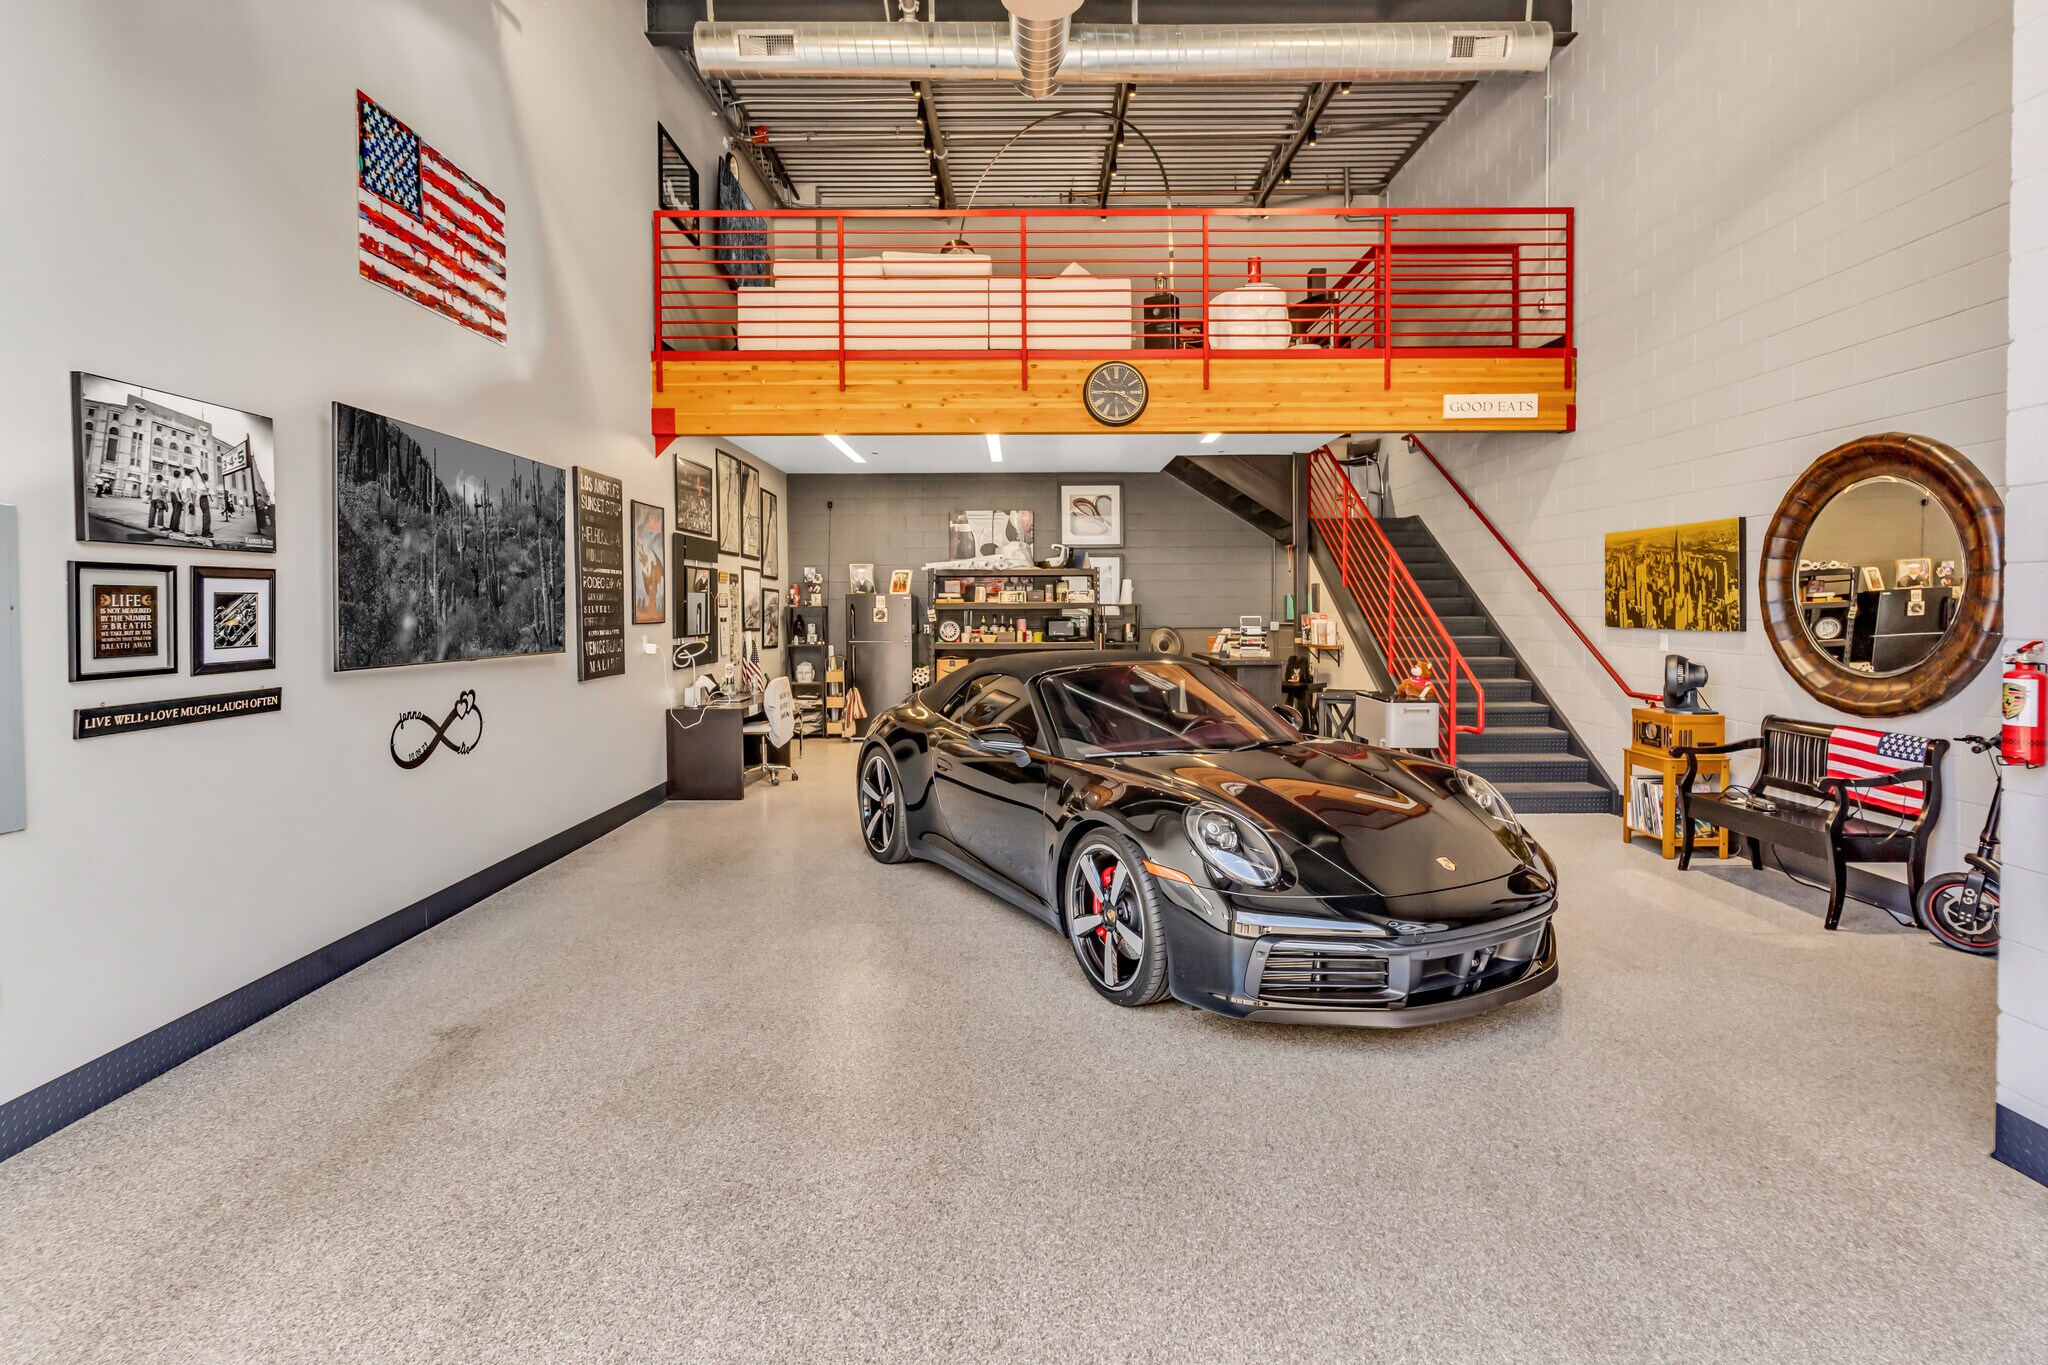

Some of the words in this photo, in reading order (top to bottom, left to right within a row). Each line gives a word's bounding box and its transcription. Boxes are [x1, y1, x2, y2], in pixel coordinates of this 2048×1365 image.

[1449, 401, 1493, 412] GOOD
[1498, 401, 1533, 412] EATS
[580, 474, 593, 492] LOS
[581, 494, 604, 513] SUNSET
[111, 594, 141, 607] LIFE
[110, 622, 153, 630] BREATHS
[132, 641, 152, 649] AWAY
[589, 657, 620, 673] MALIB
[84, 716, 112, 730] LIVE
[114, 712, 144, 726] WELL
[150, 708, 179, 722] LOVE
[180, 704, 211, 717] MUCH
[216, 700, 249, 713] LAUGH
[250, 696, 278, 708] OFTEN
